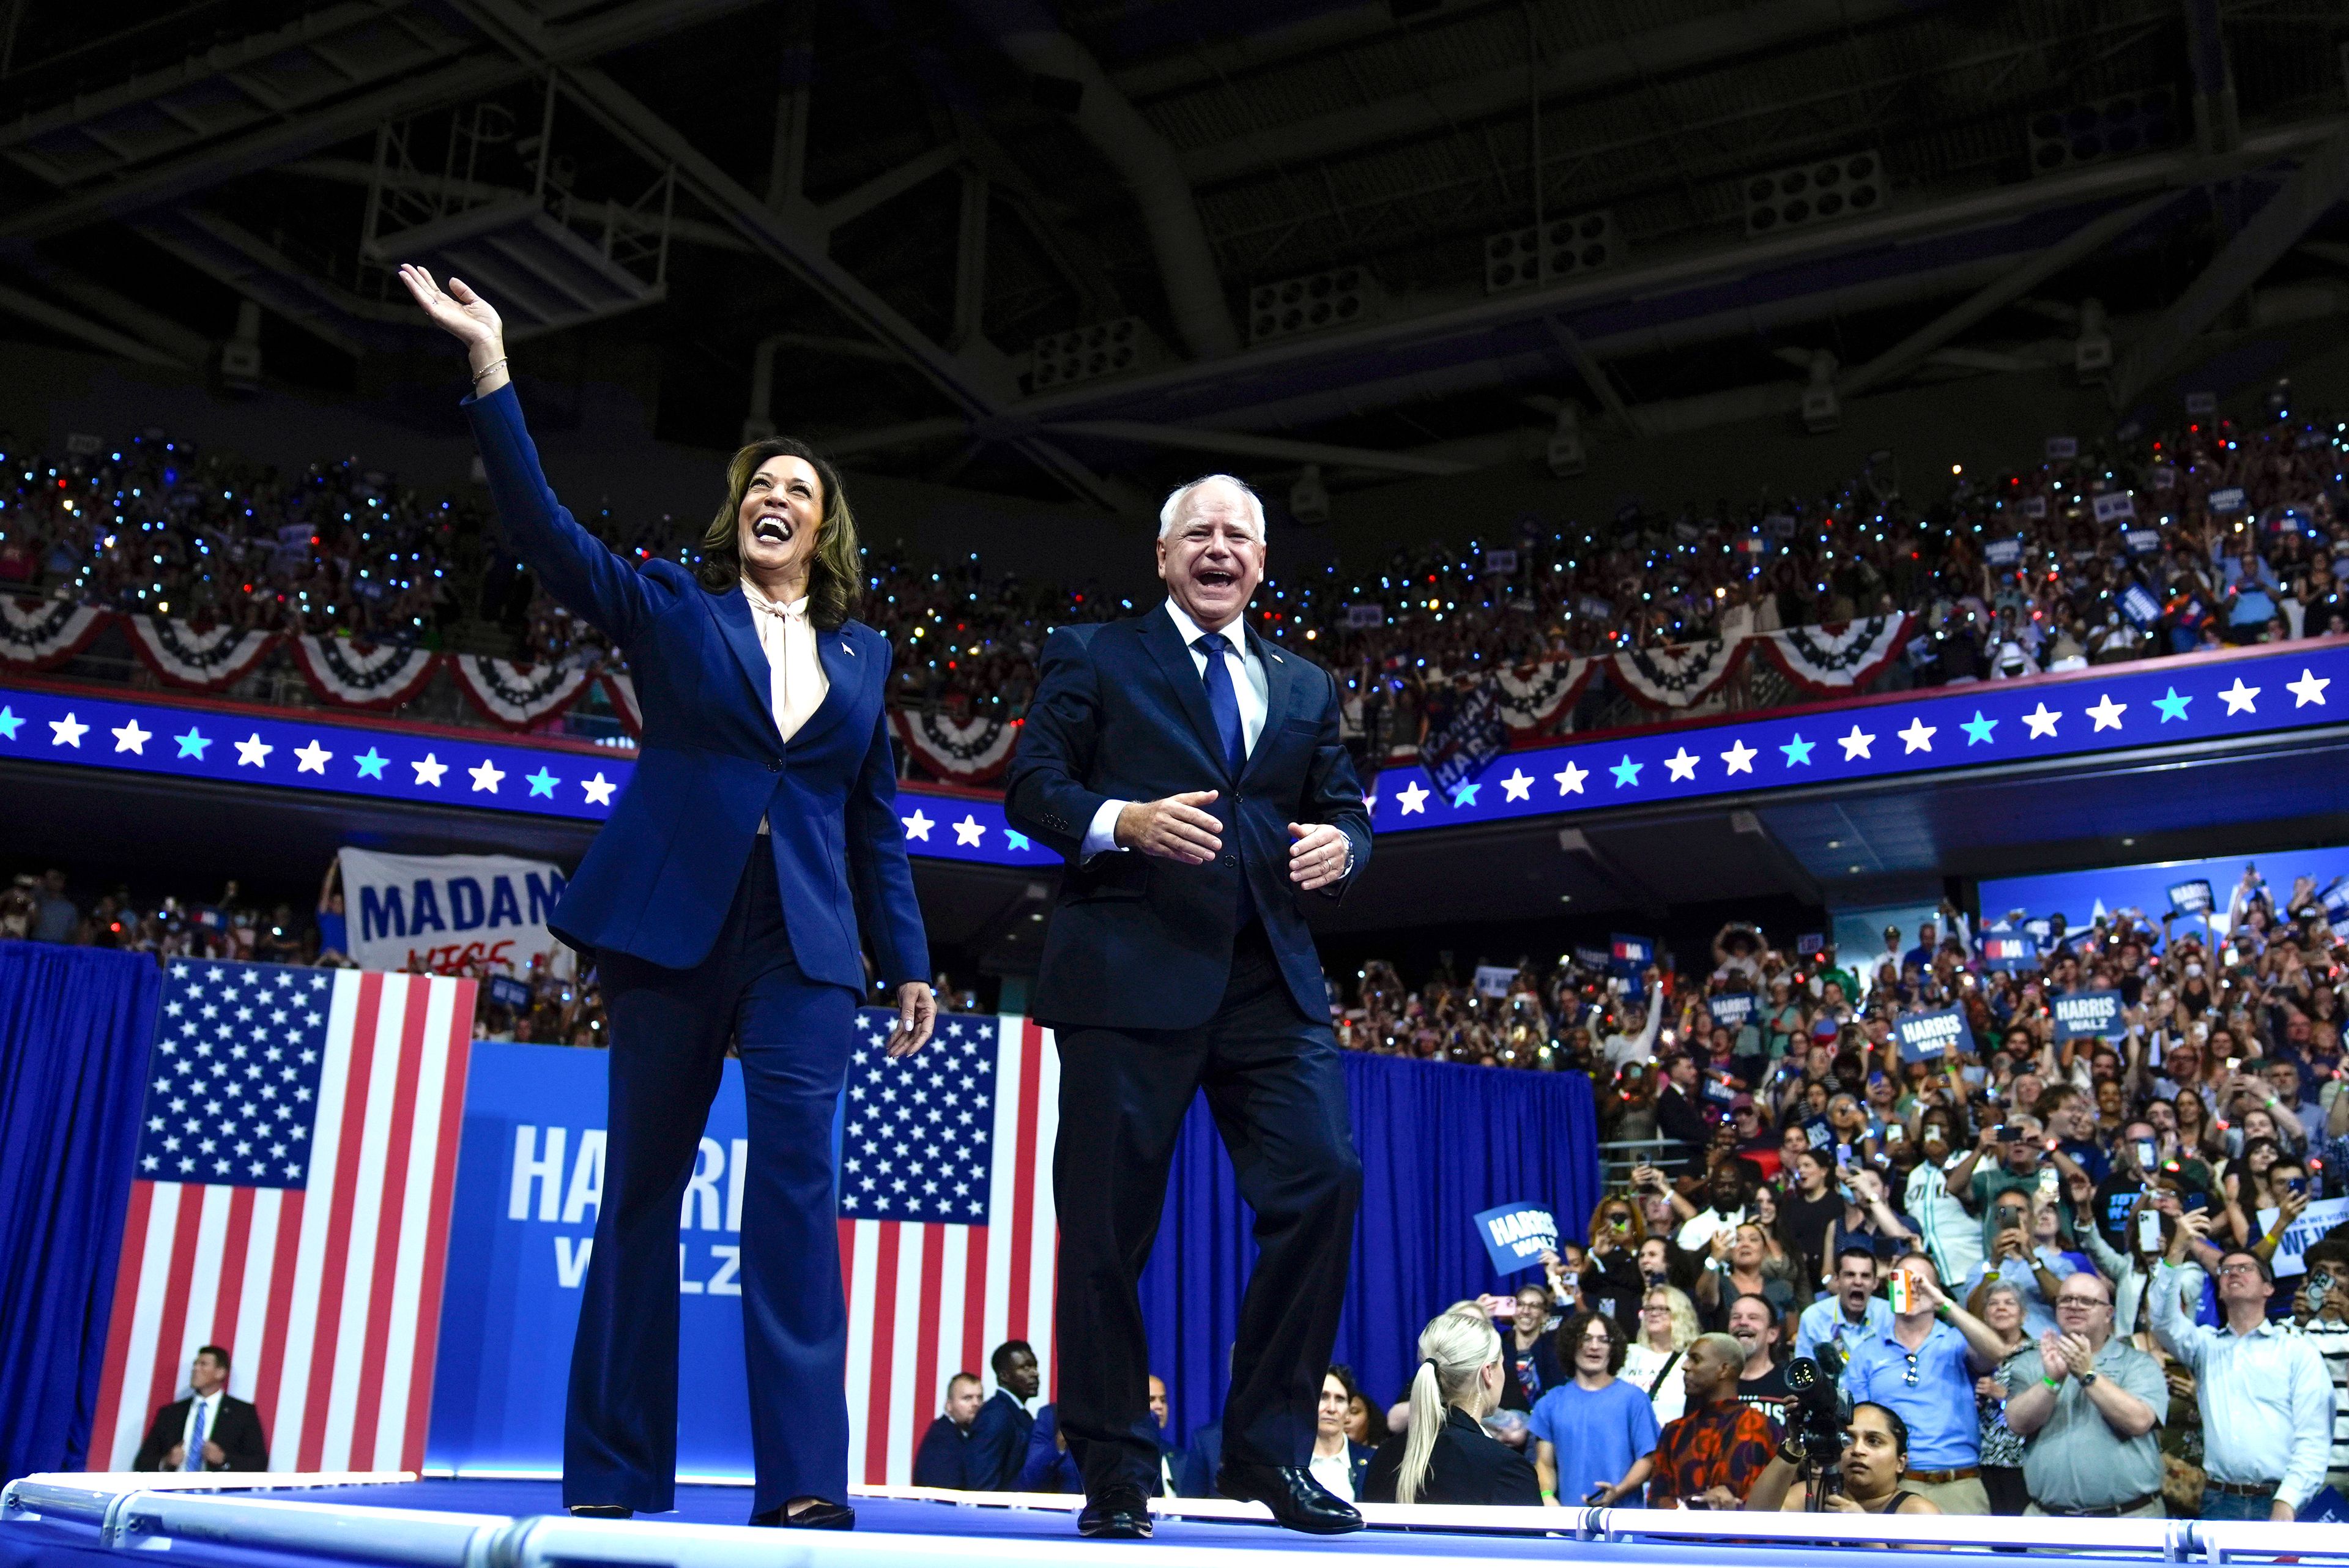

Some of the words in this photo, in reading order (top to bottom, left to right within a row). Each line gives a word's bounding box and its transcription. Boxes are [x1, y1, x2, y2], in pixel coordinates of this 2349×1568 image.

[2057, 996, 2116, 1022] HARRIS
[1902, 1014, 1962, 1044] HARRIS
[2068, 1017, 2109, 1033] WALZ
[1917, 1034, 1958, 1052] WALZ
[507, 1124, 748, 1232] HARI
[1488, 1209, 1559, 1247] HARRIS
[1512, 1235, 1559, 1258] WALZ
